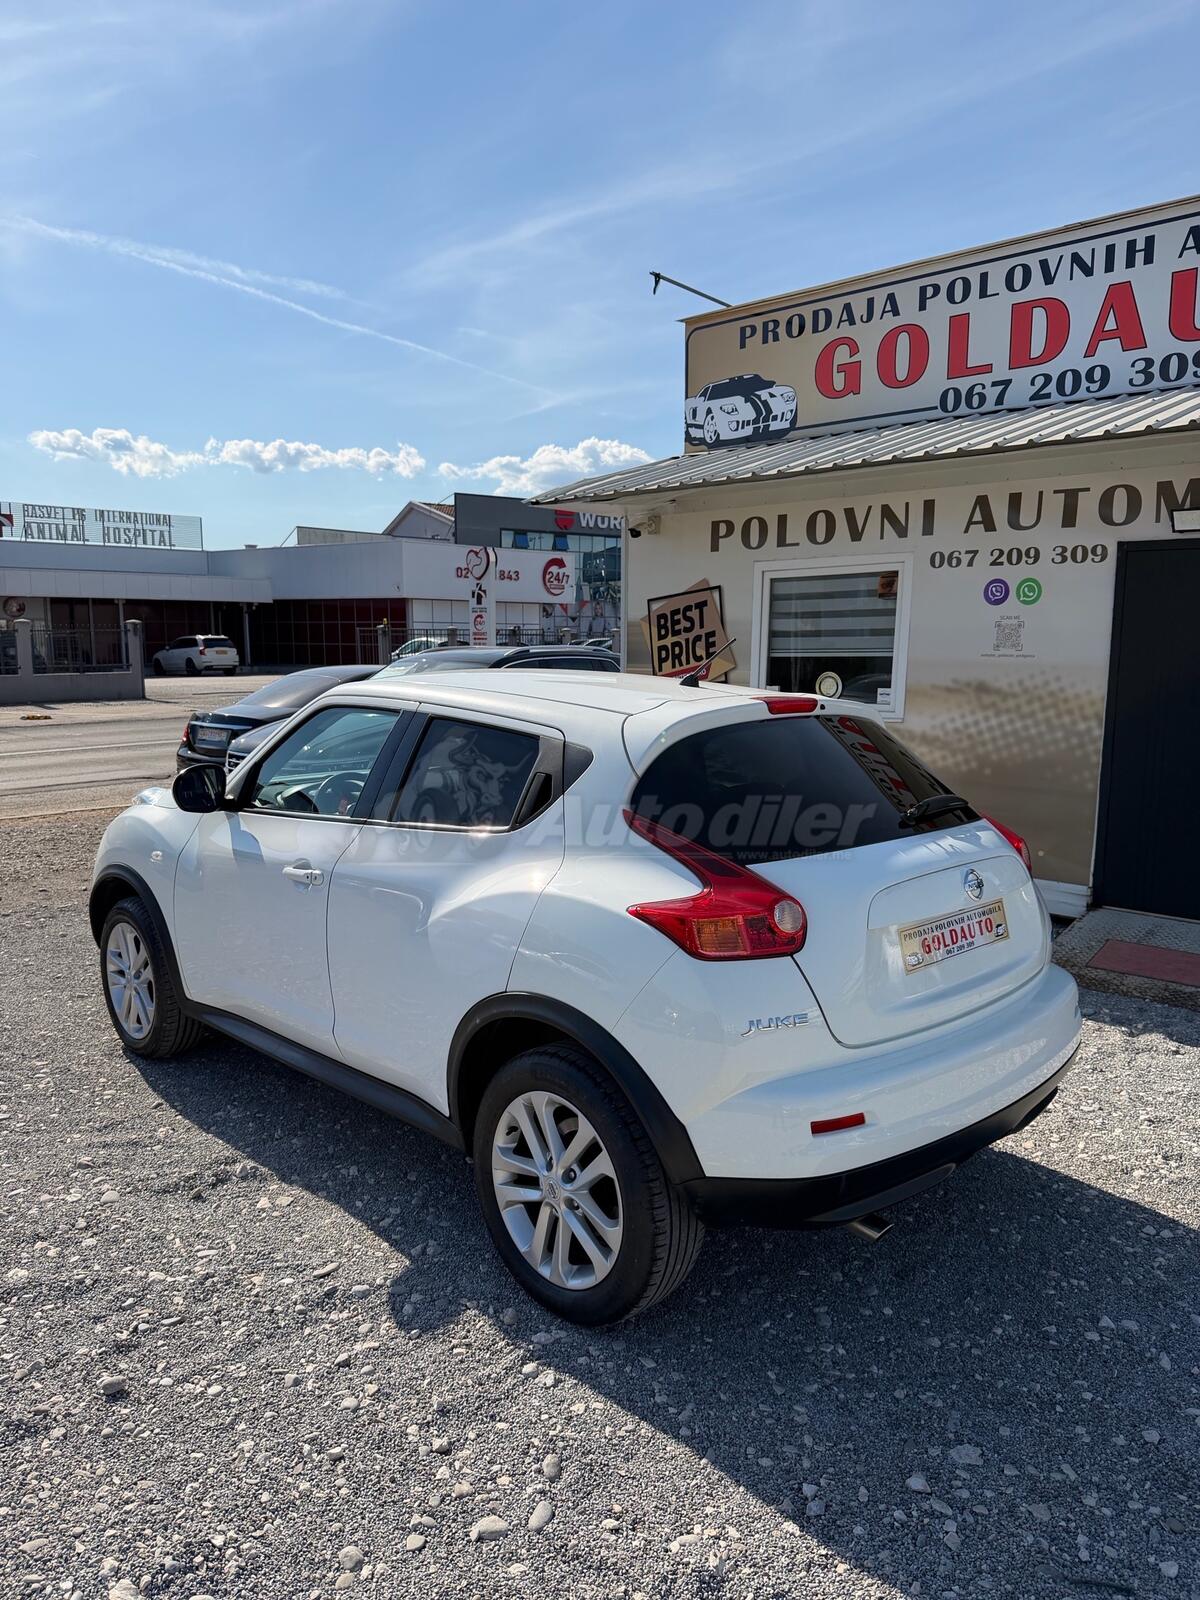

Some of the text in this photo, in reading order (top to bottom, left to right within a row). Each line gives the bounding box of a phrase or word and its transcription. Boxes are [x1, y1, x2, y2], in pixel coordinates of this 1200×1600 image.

[739, 287, 901, 349] PRODAJA
[918, 234, 1156, 312] POLOVNIH
[939, 379, 1013, 413] 067
[1028, 364, 1111, 401] 209
[26, 522, 176, 547] ANIMAL HOSPITAL
[710, 499, 936, 552] POLOVNI
[929, 543, 1108, 568] 067 209 309
[547, 571, 570, 584] 24/7
[656, 600, 708, 641] BEST
[657, 630, 716, 672] PRICE
[903, 904, 1002, 942] PRODAJA POLOVNIH AUTOMOBILA
[921, 917, 993, 955] GOLDAUTO
[740, 1012, 809, 1037] JUKE
